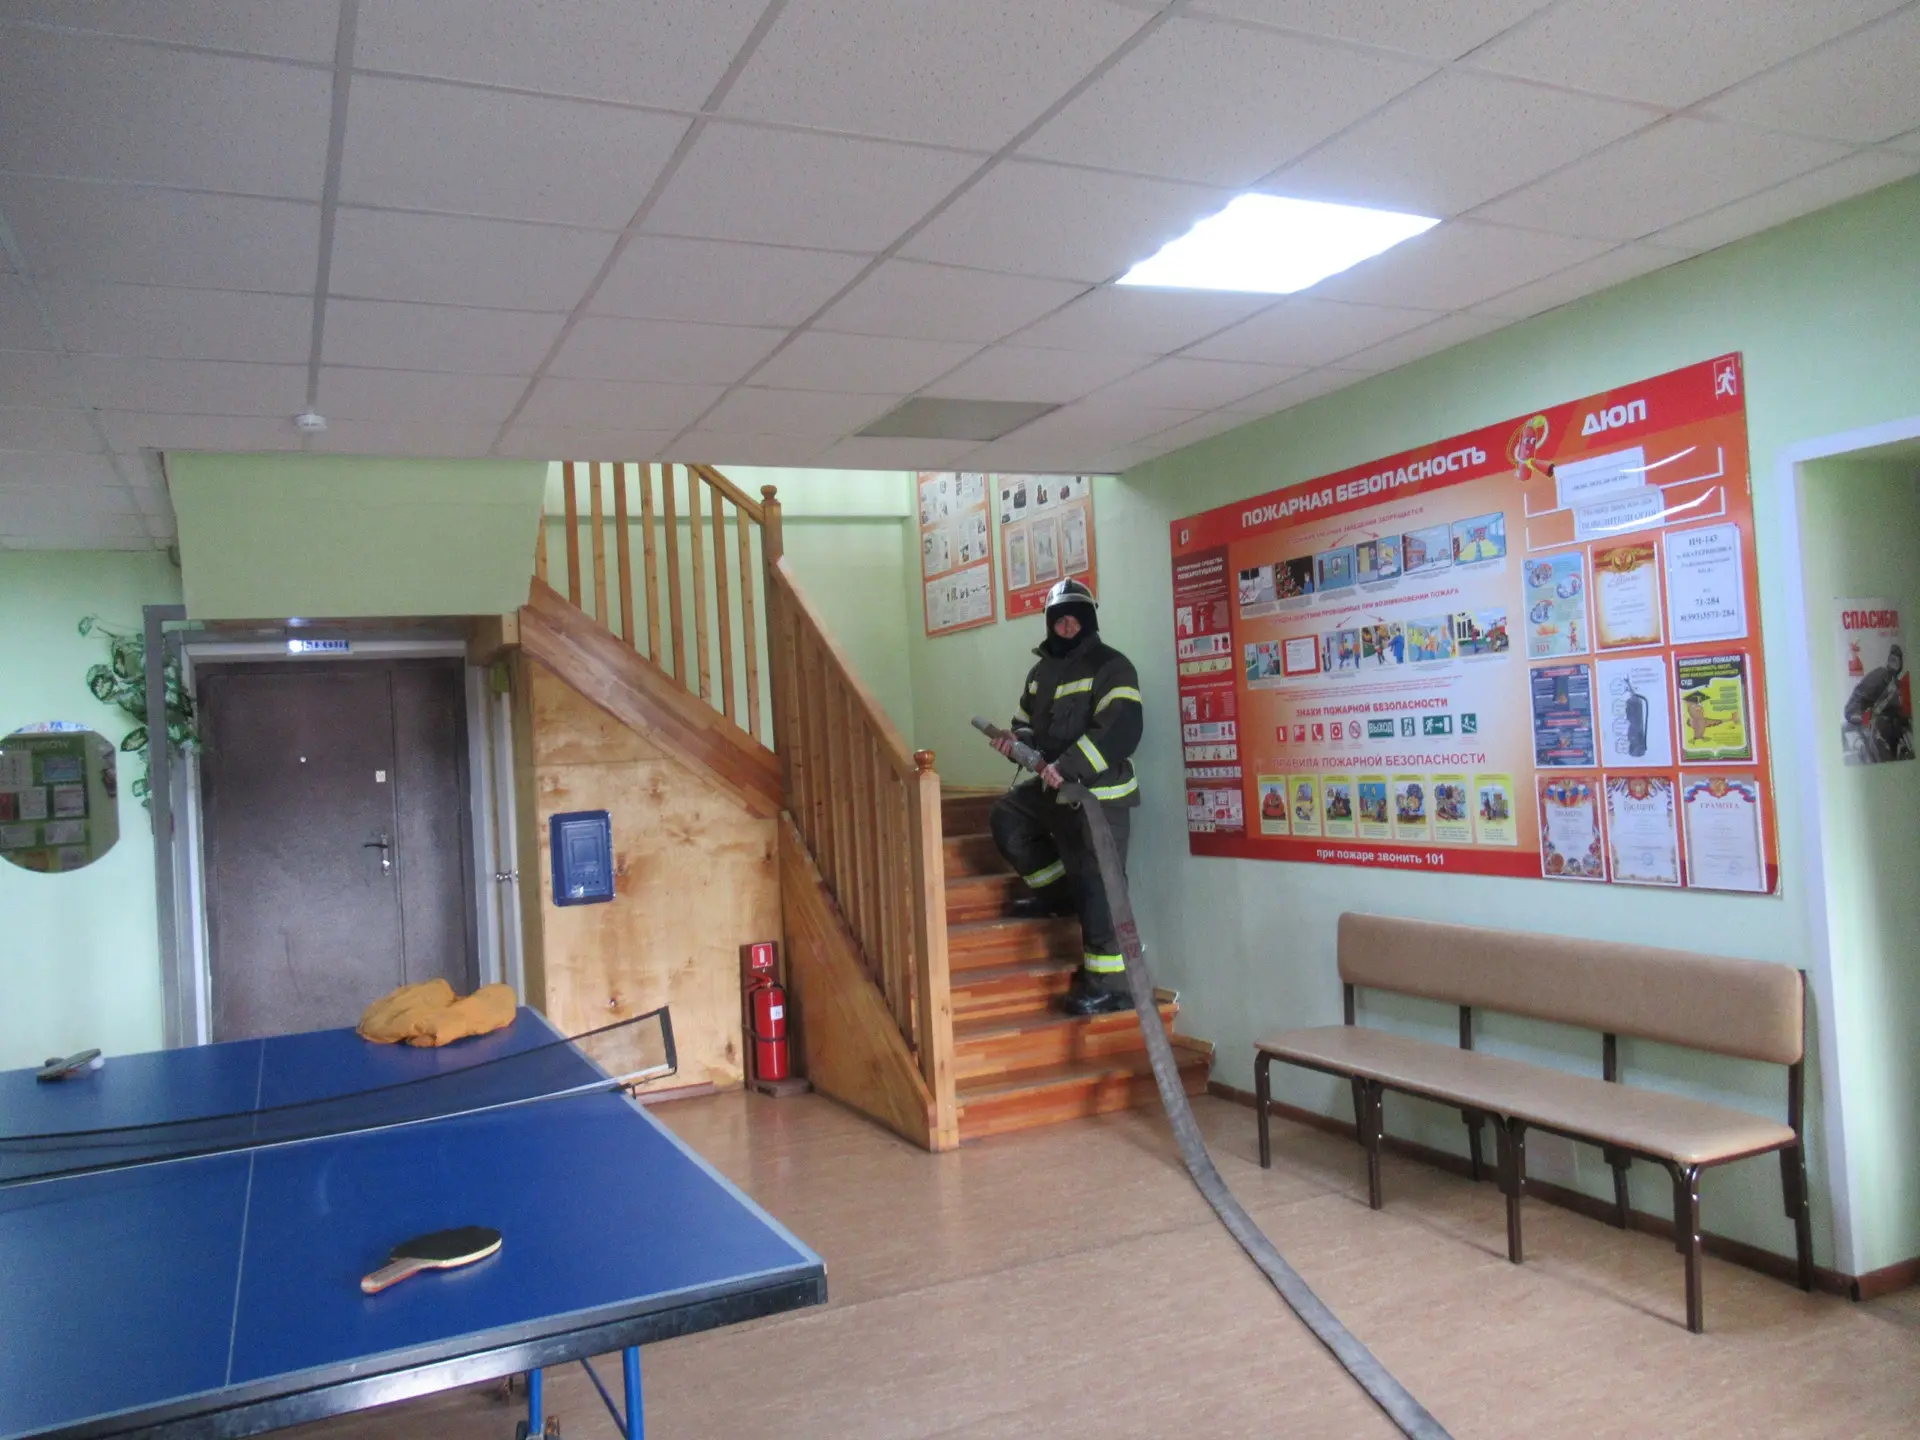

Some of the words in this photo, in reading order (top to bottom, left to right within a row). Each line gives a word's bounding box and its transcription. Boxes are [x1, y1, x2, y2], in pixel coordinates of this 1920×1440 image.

[1581, 399, 1647, 436] ДЮП
[1241, 488, 1334, 528] ПОЖАРНАЯ
[1336, 446, 1487, 502] БЕЗОПАСНОСТЬ
[1430, 587, 1460, 600] ПОЖАРА
[1296, 706, 1322, 718] ЗНАКИ
[1323, 701, 1371, 715] ПОЖАРНОЙ
[1373, 698, 1448, 713] БЕЗОПАСНОСТИ
[1368, 721, 1394, 735] ВЫХОД
[1273, 757, 1319, 769] ПРАВИЛА
[1322, 754, 1383, 768] ПОЖАРНОЙ
[1385, 753, 1486, 767] БЕЗОПАСНОСТИ
[1700, 802, 1740, 810] ГРАМОТА
[1316, 848, 1335, 860] при
[1337, 850, 1375, 863] пожаре
[1377, 852, 1423, 865] звонить
[1425, 853, 1445, 865] 101
